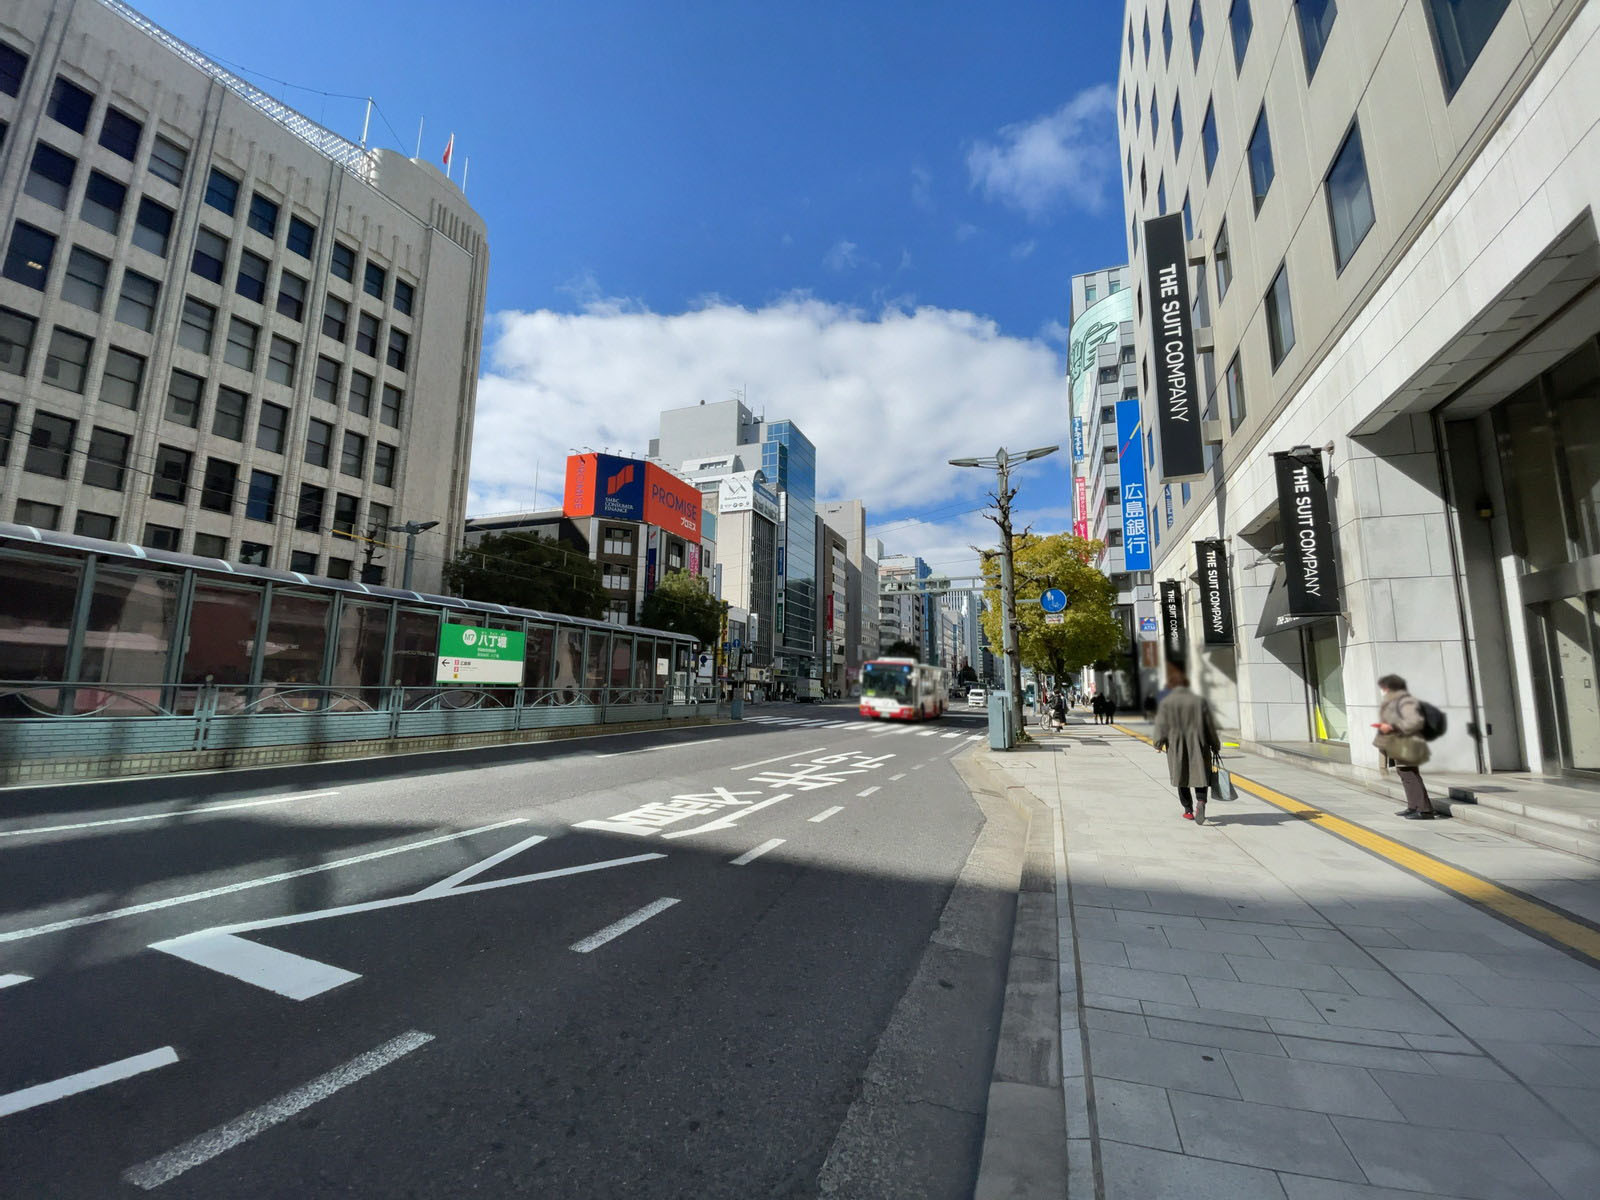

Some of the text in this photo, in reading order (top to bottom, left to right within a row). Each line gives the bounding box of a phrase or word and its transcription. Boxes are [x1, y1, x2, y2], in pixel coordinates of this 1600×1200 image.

[1159, 263, 1189, 422] THE SUIT COMPANY
[604, 502, 634, 510] CONSUMER
[651, 483, 697, 521] PROMISE
[680, 517, 697, 532] プロミス
[1125, 483, 1147, 555] 広島銀行
[1293, 466, 1321, 597] THE SUIT COMPANY
[1167, 589, 1175, 603] THE
[1206, 550, 1225, 634] THE SUIT COMPANY
[1168, 604, 1177, 620] SUIT
[464, 633, 475, 641] M7
[478, 635, 507, 648] 八丁堀
[570, 764, 869, 839] 優先
